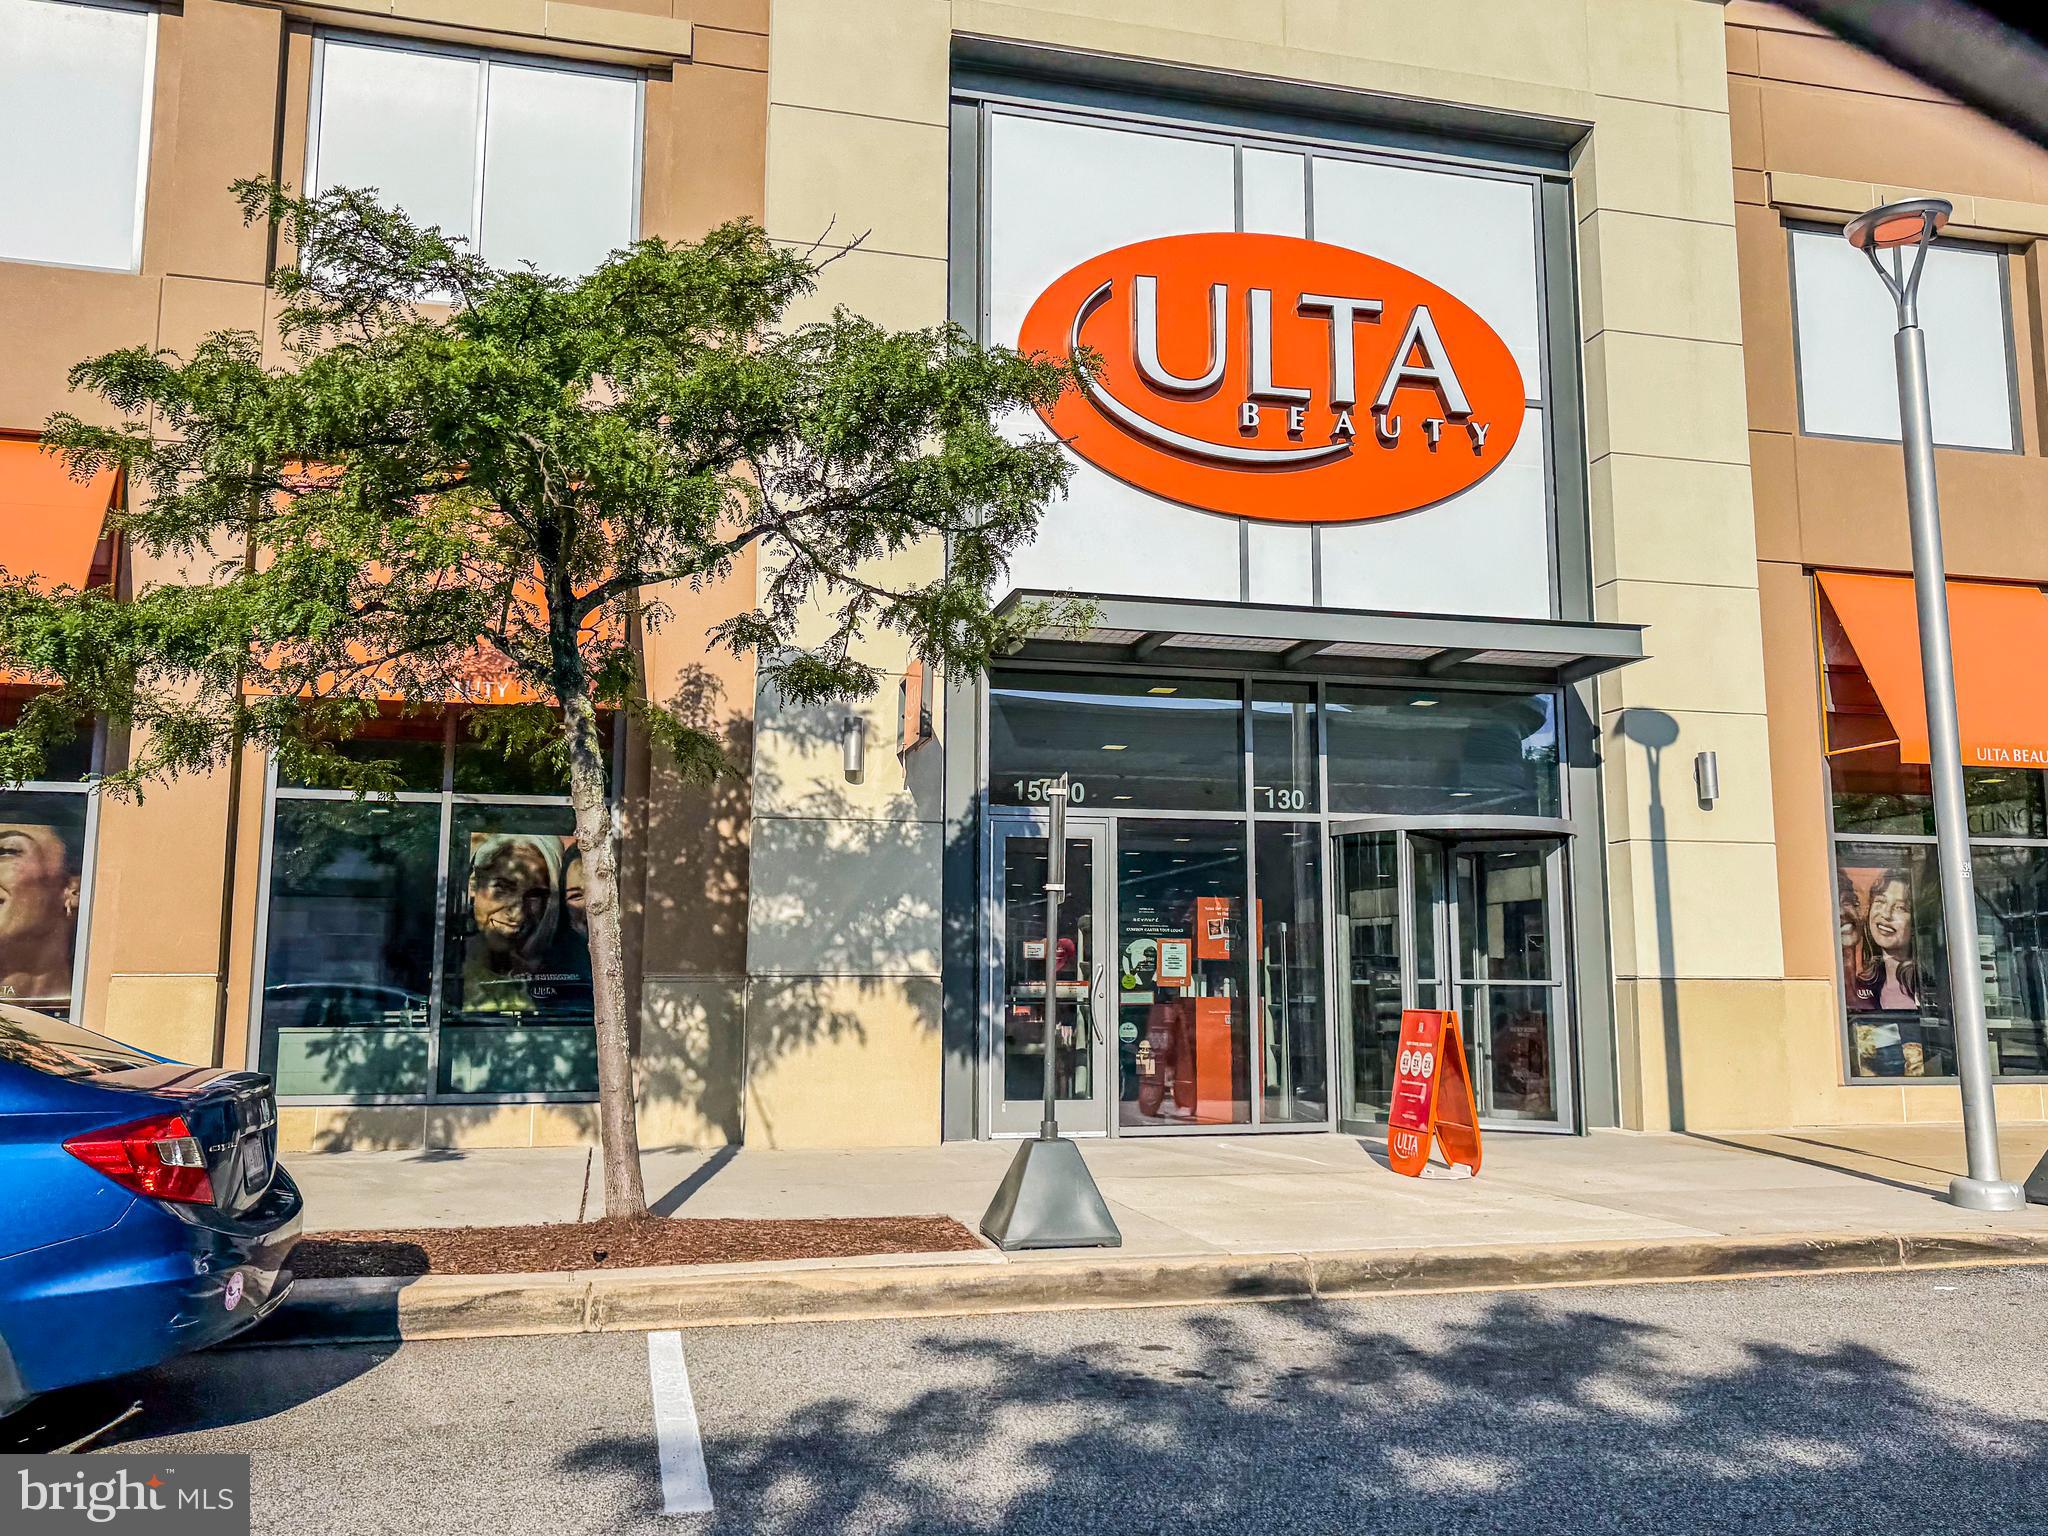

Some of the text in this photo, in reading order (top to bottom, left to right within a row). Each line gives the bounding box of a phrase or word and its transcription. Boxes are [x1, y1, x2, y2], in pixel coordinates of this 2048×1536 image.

[1134, 274, 1474, 419] ULTA
[1240, 401, 1490, 455] BEAUTY
[1977, 748, 2048, 763] ULTA BEAU
[1265, 789, 1304, 809] 130
[1397, 1132, 1418, 1152] ULTA
